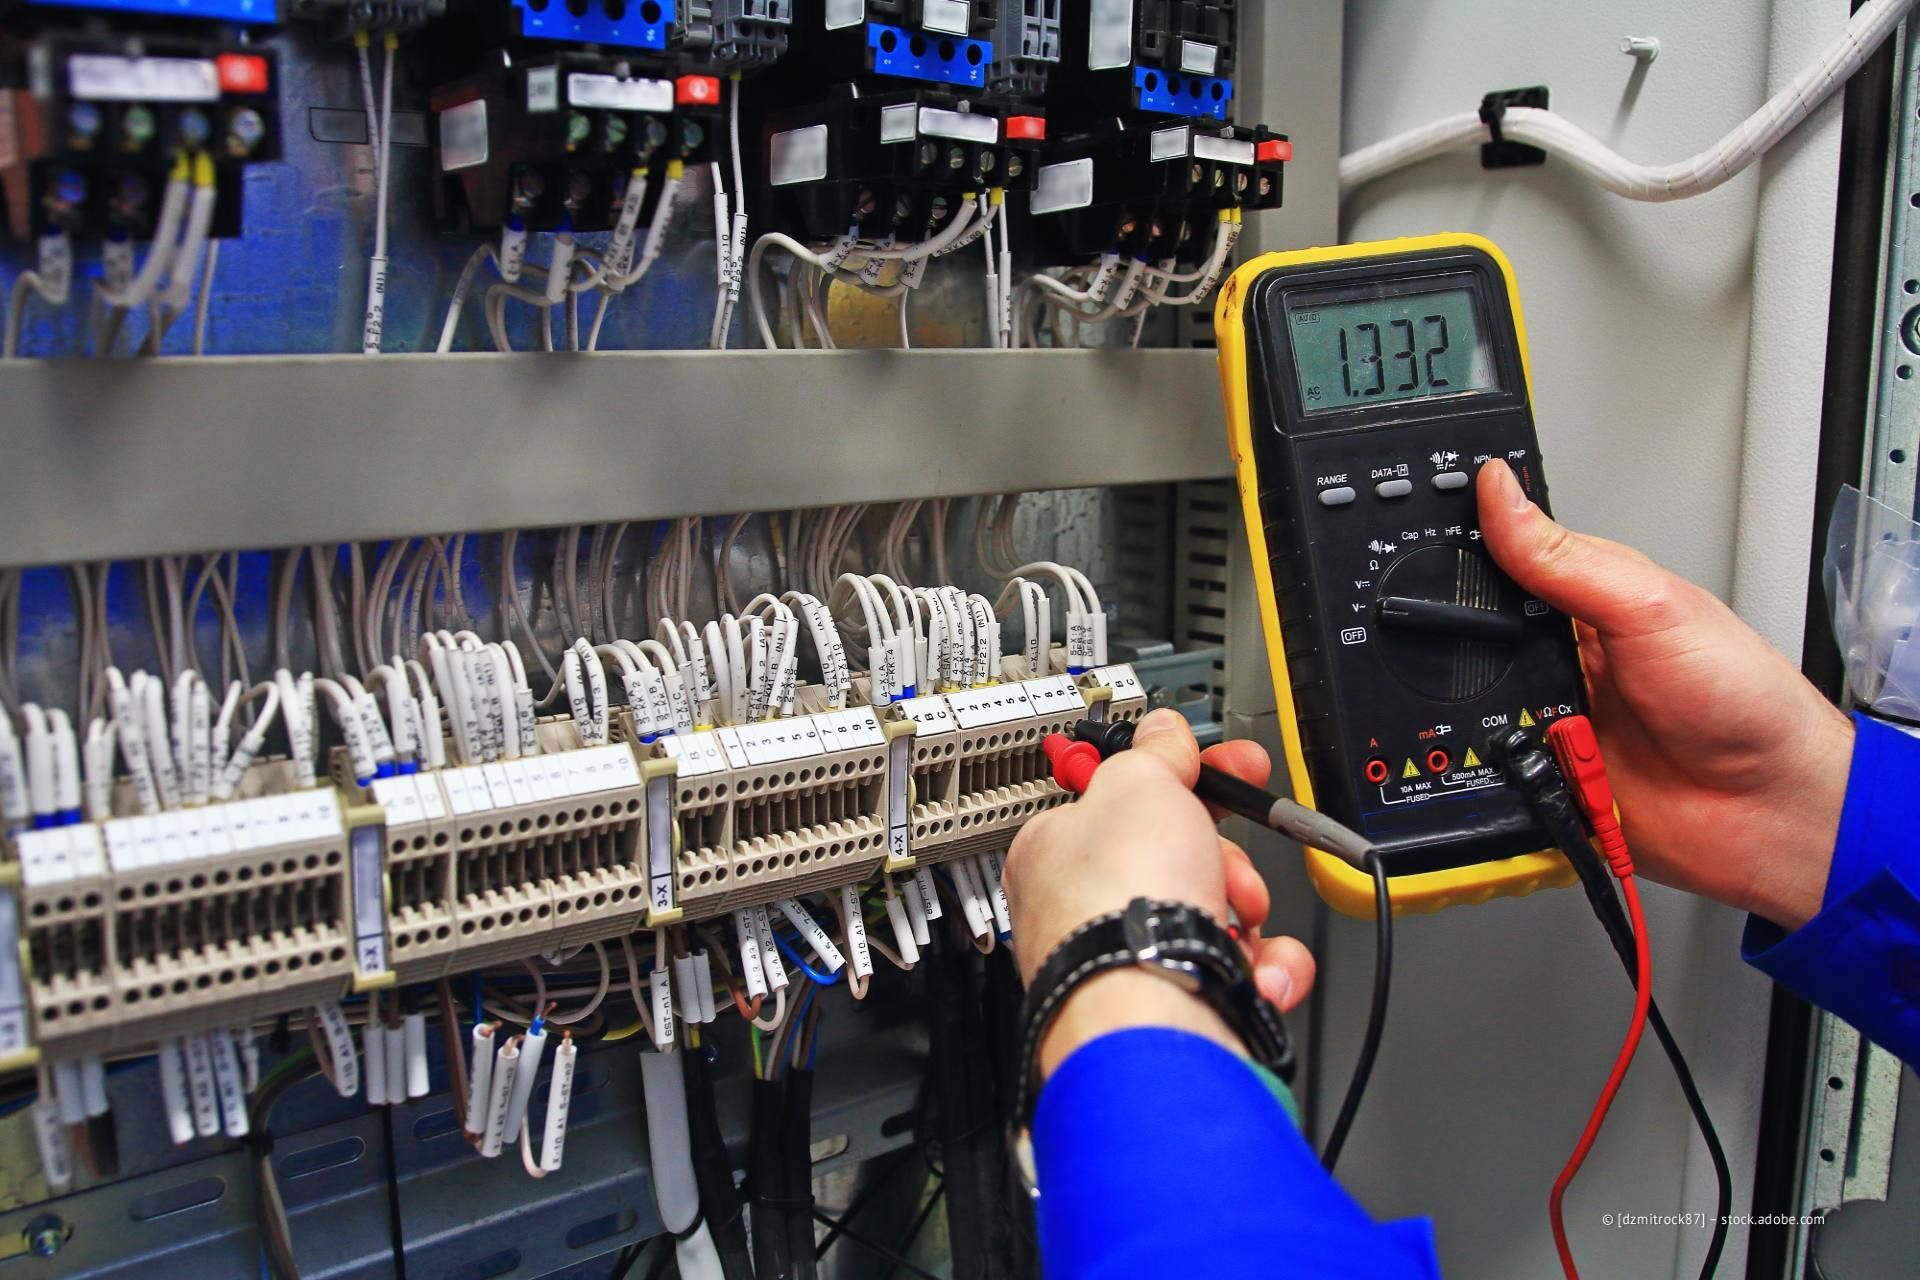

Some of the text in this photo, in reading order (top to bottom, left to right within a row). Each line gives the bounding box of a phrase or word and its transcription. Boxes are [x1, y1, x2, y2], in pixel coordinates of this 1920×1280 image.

[1339, 315, 1449, 398] 1.332
[1307, 386, 1320, 396] AC
[1508, 450, 1526, 460] PNP
[1316, 474, 1348, 486] RANGE
[1402, 526, 1462, 544] Cap Hz hFE
[1344, 630, 1363, 642] OFF
[1067, 685, 1078, 696] 10
[865, 719, 877, 732] 10
[1482, 714, 1508, 728] COM
[1418, 728, 1436, 740] mA
[1370, 738, 1378, 748] A
[690, 752, 701, 760] B
[706, 748, 716, 757] C
[1452, 768, 1494, 780] 500mA MAX
[1416, 782, 1432, 790] MAX
[1466, 778, 1490, 788] FUSED
[1406, 794, 1430, 804] FUSED
[894, 834, 903, 855] 4-X
[657, 884, 667, 908] 3-X
